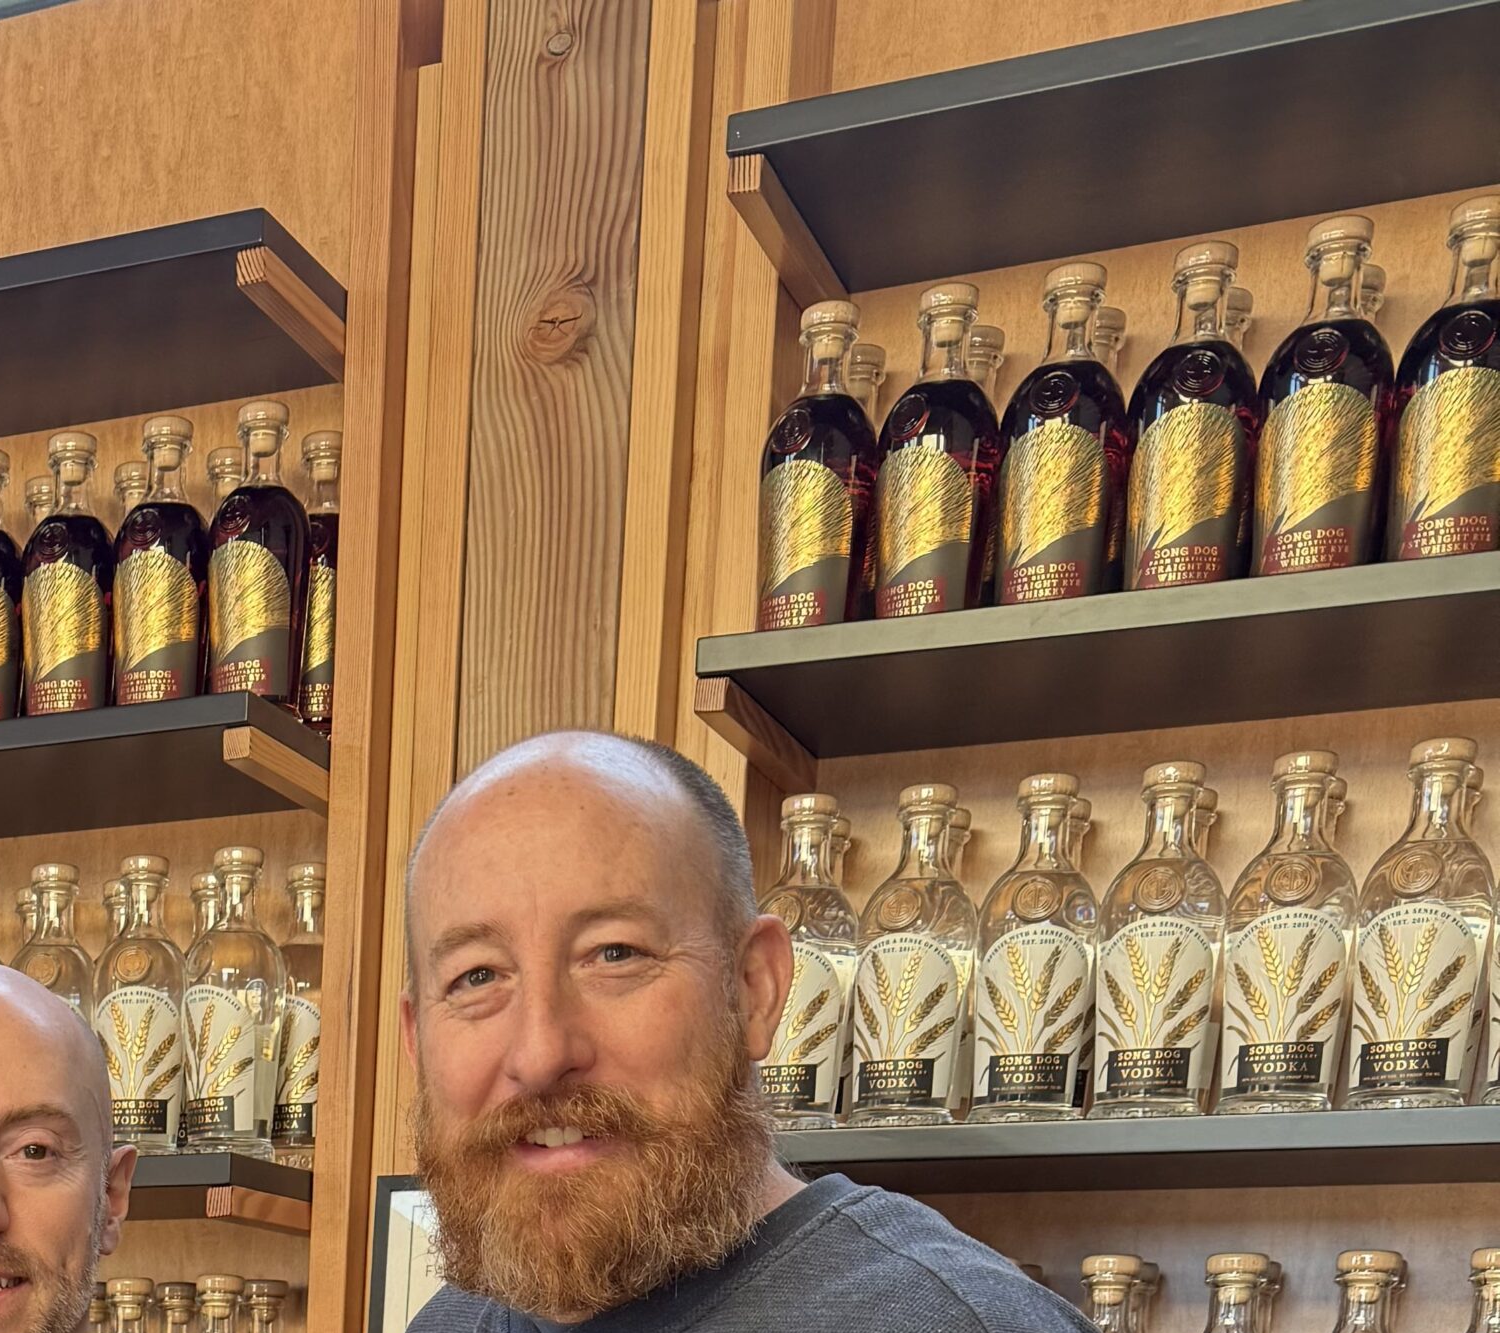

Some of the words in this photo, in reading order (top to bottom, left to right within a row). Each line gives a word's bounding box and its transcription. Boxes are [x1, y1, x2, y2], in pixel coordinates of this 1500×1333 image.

[1417, 517, 1455, 531] SONG
[1459, 516, 1488, 526] DOG
[1277, 530, 1312, 545] SONG
[1316, 528, 1345, 539] DOG
[1407, 533, 1470, 549] STRAIGHT
[1472, 533, 1491, 542] RYE
[1154, 546, 1189, 559] SONG
[1194, 546, 1218, 556] DOG
[1268, 545, 1327, 562] STRAIGHT
[1330, 544, 1350, 553] RYE
[1420, 542, 1477, 555] WHISKEY
[1280, 554, 1334, 568] WHISKEY
[1013, 564, 1045, 578] SONG
[1049, 562, 1076, 573] DOG
[1145, 562, 1202, 576] STRAIGHT
[1062, 579, 1081, 587] RYE
[1157, 571, 1209, 583] WHISKEY
[908, 580, 934, 592] DOG
[790, 592, 815, 602] DOG
[1016, 587, 1067, 600] WHISKEY
[238, 659, 260, 669] DOG
[149, 670, 172, 679] DOG
[34, 679, 58, 691] SONG
[60, 679, 82, 688] DOG
[1260, 914, 1282, 926] WITH
[1380, 910, 1402, 922] WITH
[1412, 907, 1439, 916] SENSE
[1440, 911, 1451, 920] OF
[1392, 919, 1409, 927] EST.
[1248, 1044, 1284, 1056] SONG
[1288, 1044, 1315, 1053] DOG
[1369, 1042, 1404, 1054] SONG
[1408, 1041, 1438, 1051] DOG
[999, 1055, 1032, 1066] SONG
[1035, 1055, 1060, 1065] DOG
[1117, 1050, 1151, 1061] SONG
[1155, 1049, 1181, 1059] DOG
[780, 1066, 806, 1076] DOG
[865, 1061, 894, 1072] SONG
[897, 1060, 924, 1070] DOG
[1252, 1061, 1308, 1074] VODKA
[1372, 1059, 1431, 1073] VODKA
[1002, 1072, 1055, 1084] VODKA
[1120, 1067, 1174, 1079] VODKA
[761, 1083, 801, 1095] ODKA
[868, 1077, 918, 1089] VODKA
[138, 1100, 160, 1109] DOG
[203, 1097, 225, 1107] DOG
[282, 1104, 303, 1113] DOG
[113, 1115, 155, 1125] VODKA
